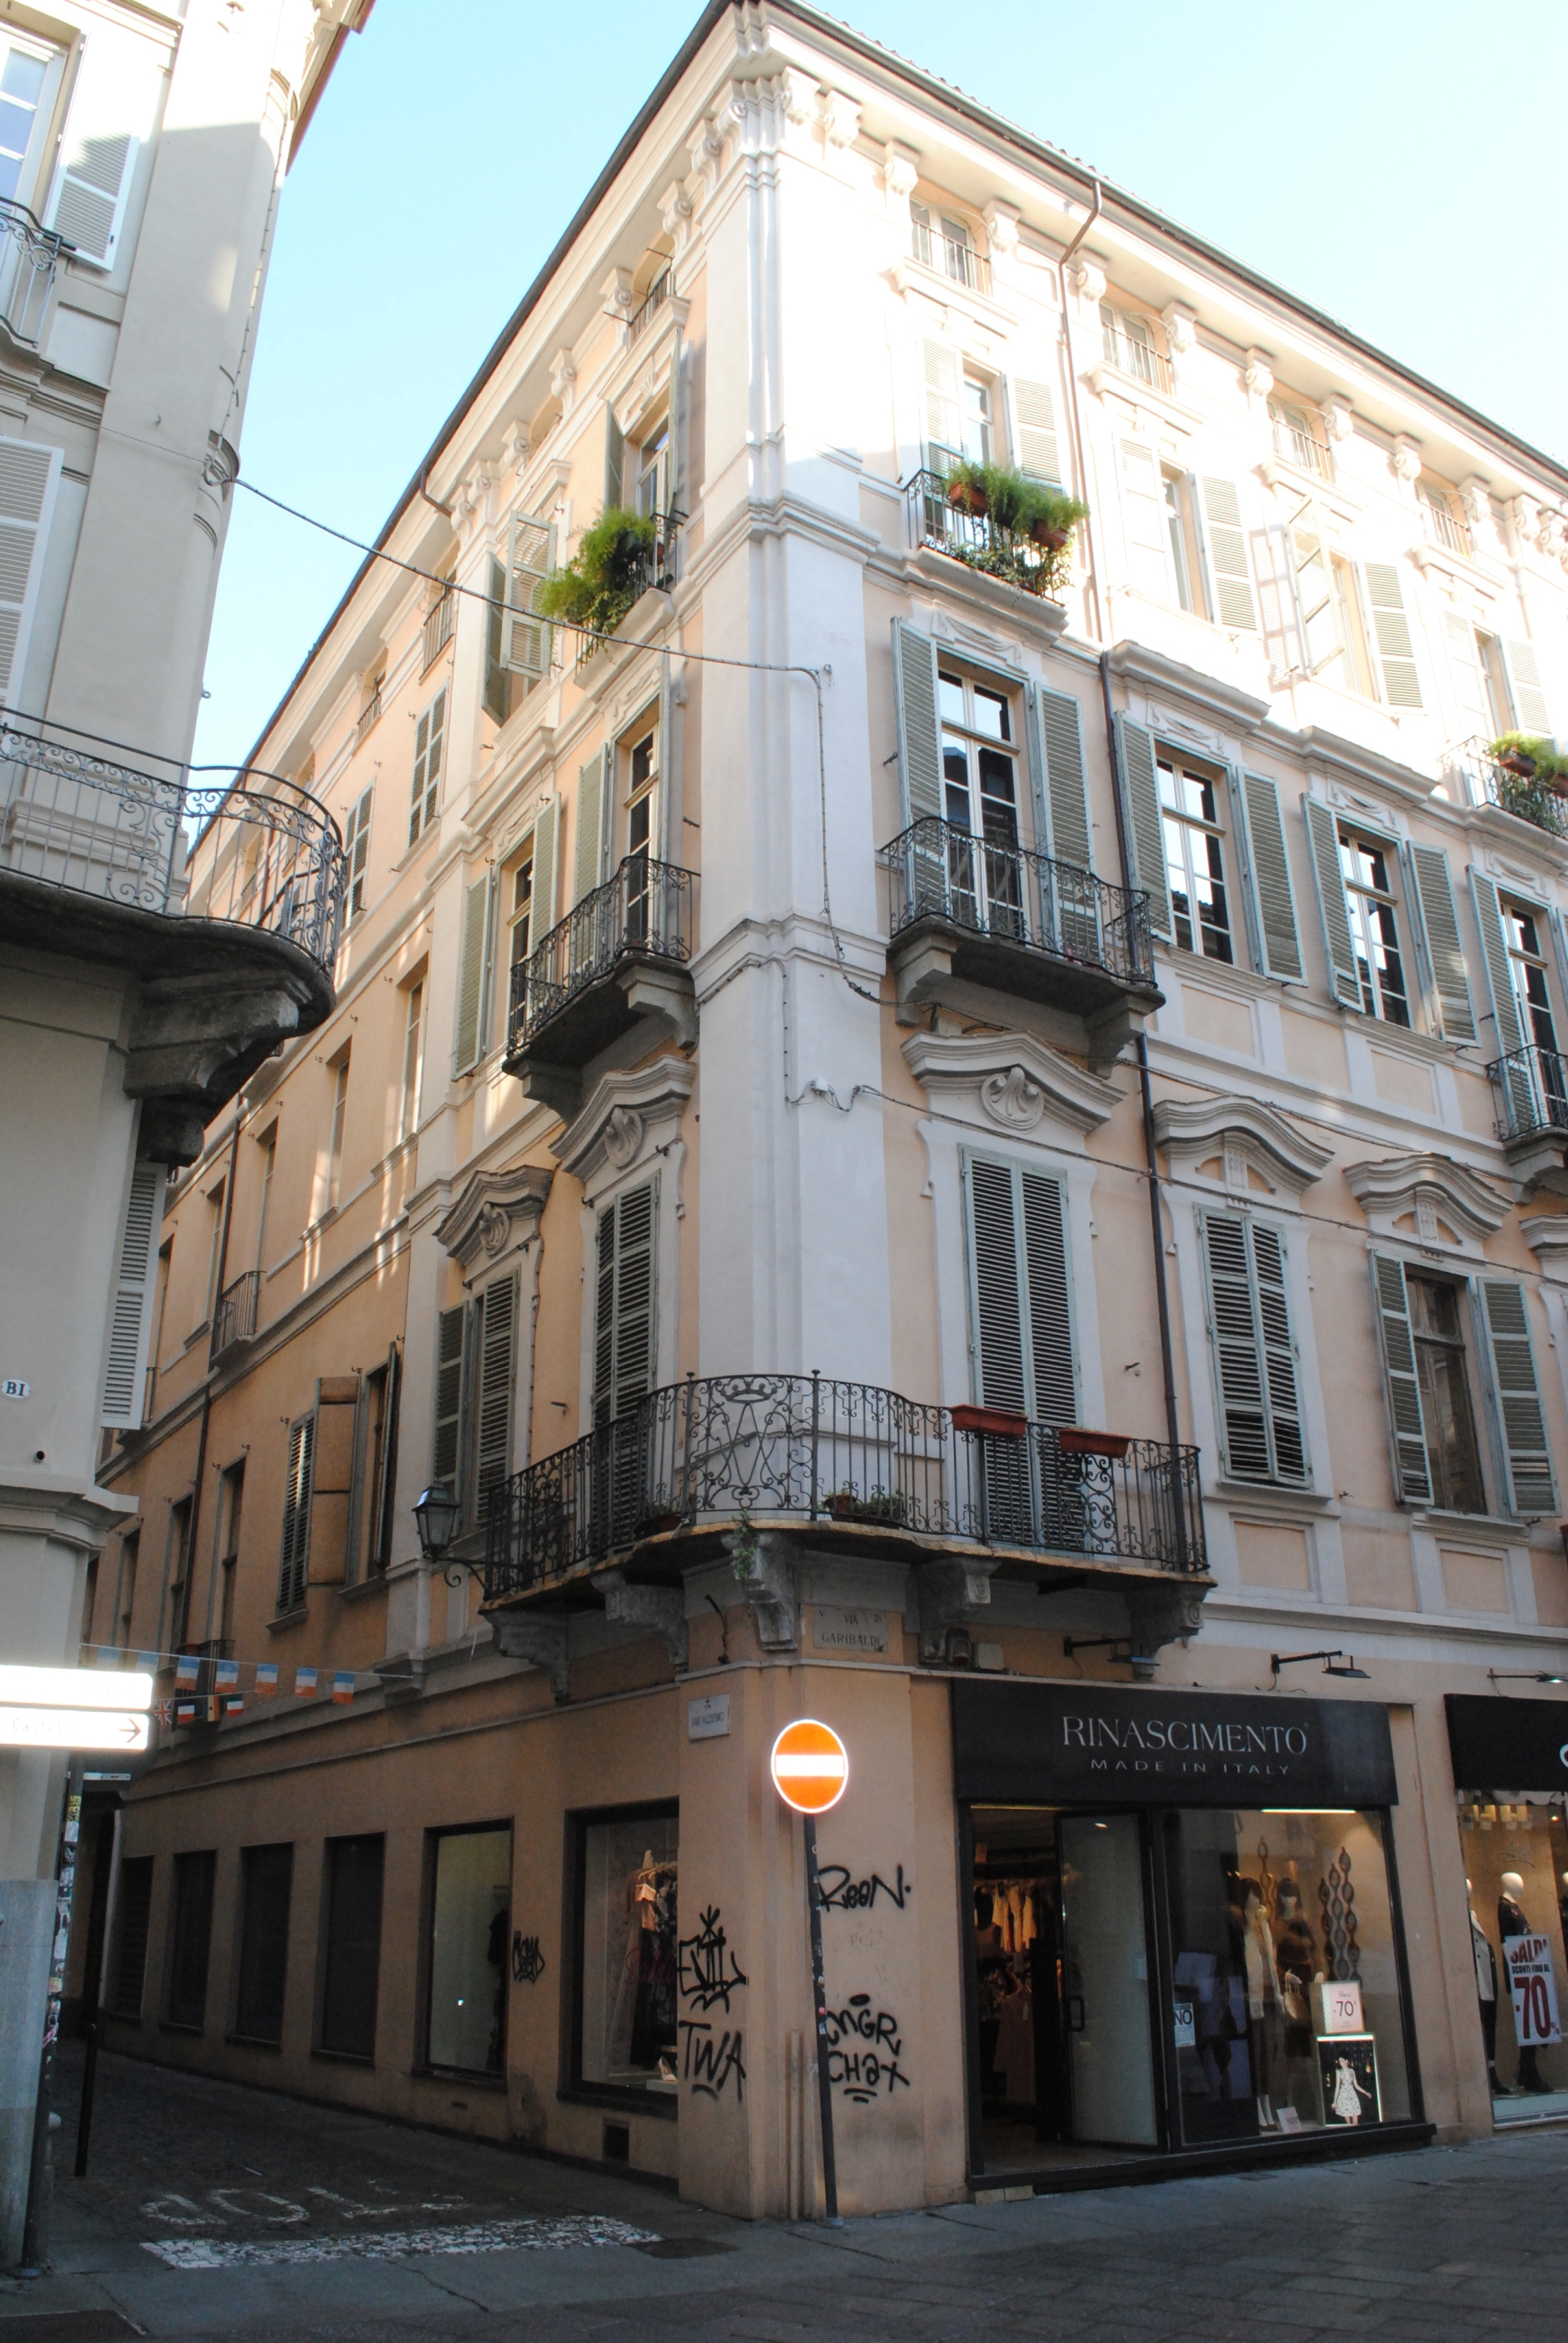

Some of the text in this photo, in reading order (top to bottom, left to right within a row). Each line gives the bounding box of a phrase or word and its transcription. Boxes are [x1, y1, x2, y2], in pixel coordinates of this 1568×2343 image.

[6, 1381, 25, 1396] BI
[843, 1613, 858, 1624] VIA
[822, 1632, 880, 1647] GARIBALDI
[1062, 1716, 1307, 1755] RINASCIMENTO
[1091, 1759, 1289, 1775] MADE IN ITALY
[1511, 1964, 1531, 1974] SCONTI
